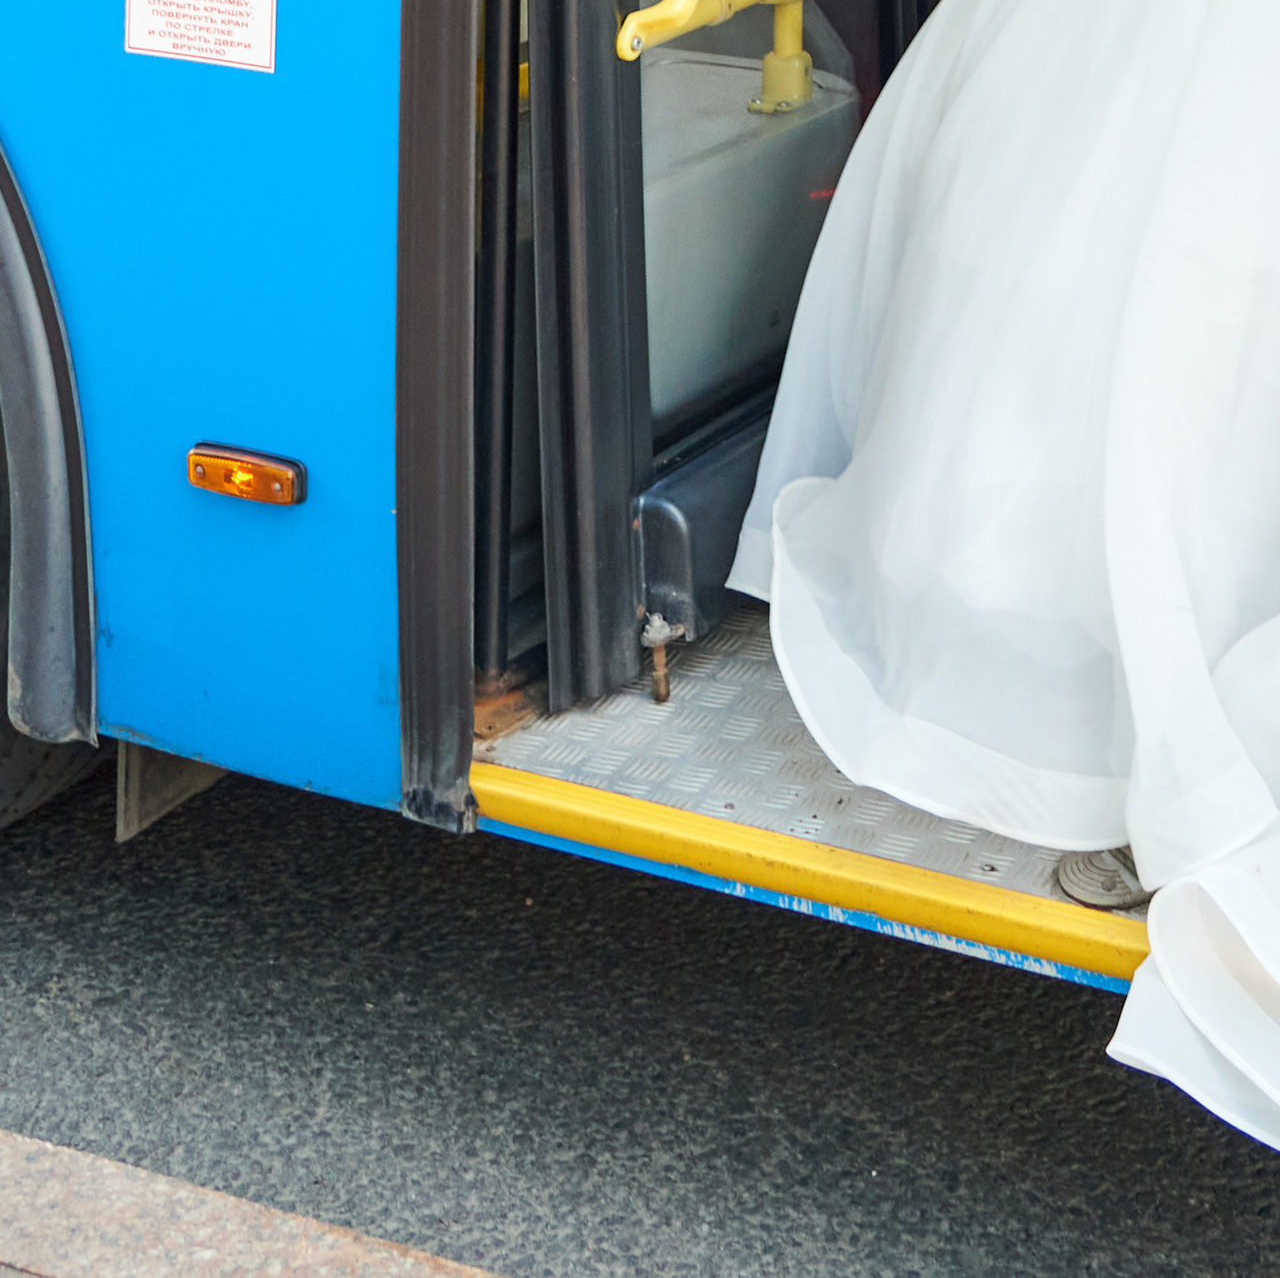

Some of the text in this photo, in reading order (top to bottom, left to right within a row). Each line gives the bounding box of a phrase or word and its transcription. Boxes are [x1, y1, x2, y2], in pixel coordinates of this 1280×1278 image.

[151, 8, 249, 28] ПОВЕРНУТЬ КРАН
[165, 21, 234, 37] ПО СТРЕЛКЕ
[158, 30, 211, 43] ОТКРЫТЬ
[214, 38, 251, 49] ДВЕРИ
[172, 42, 226, 56] ВРУЧНУЮ
